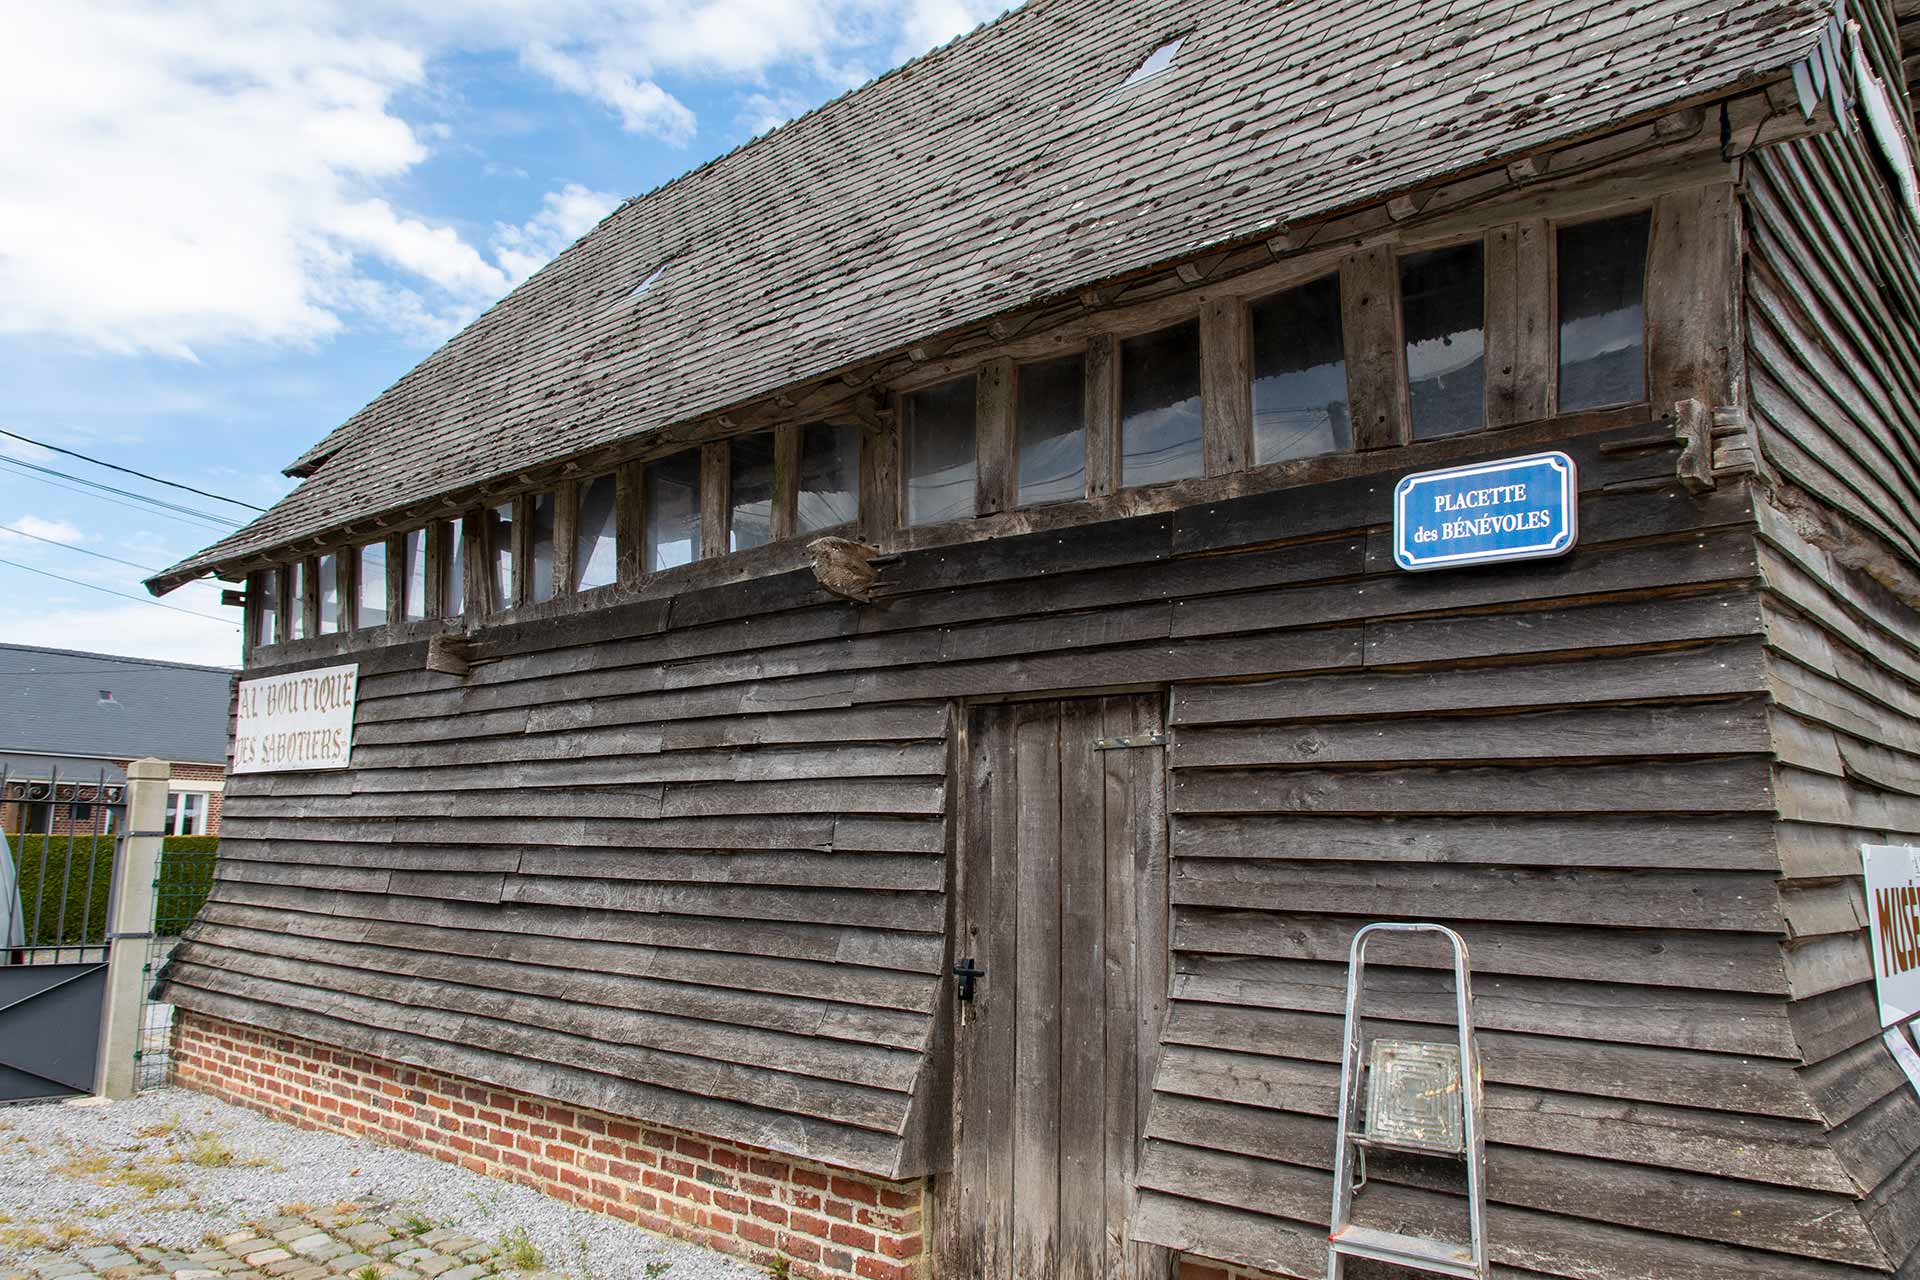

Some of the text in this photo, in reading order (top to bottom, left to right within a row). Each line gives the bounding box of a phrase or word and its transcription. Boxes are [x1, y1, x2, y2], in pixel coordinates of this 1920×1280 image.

[1434, 483, 1527, 513] PLACETTE
[1414, 509, 1550, 543] des BÉNÉVOLES
[235, 728, 342, 767] DES SABOTIERS
[1875, 880, 1920, 977] MUSÉ
